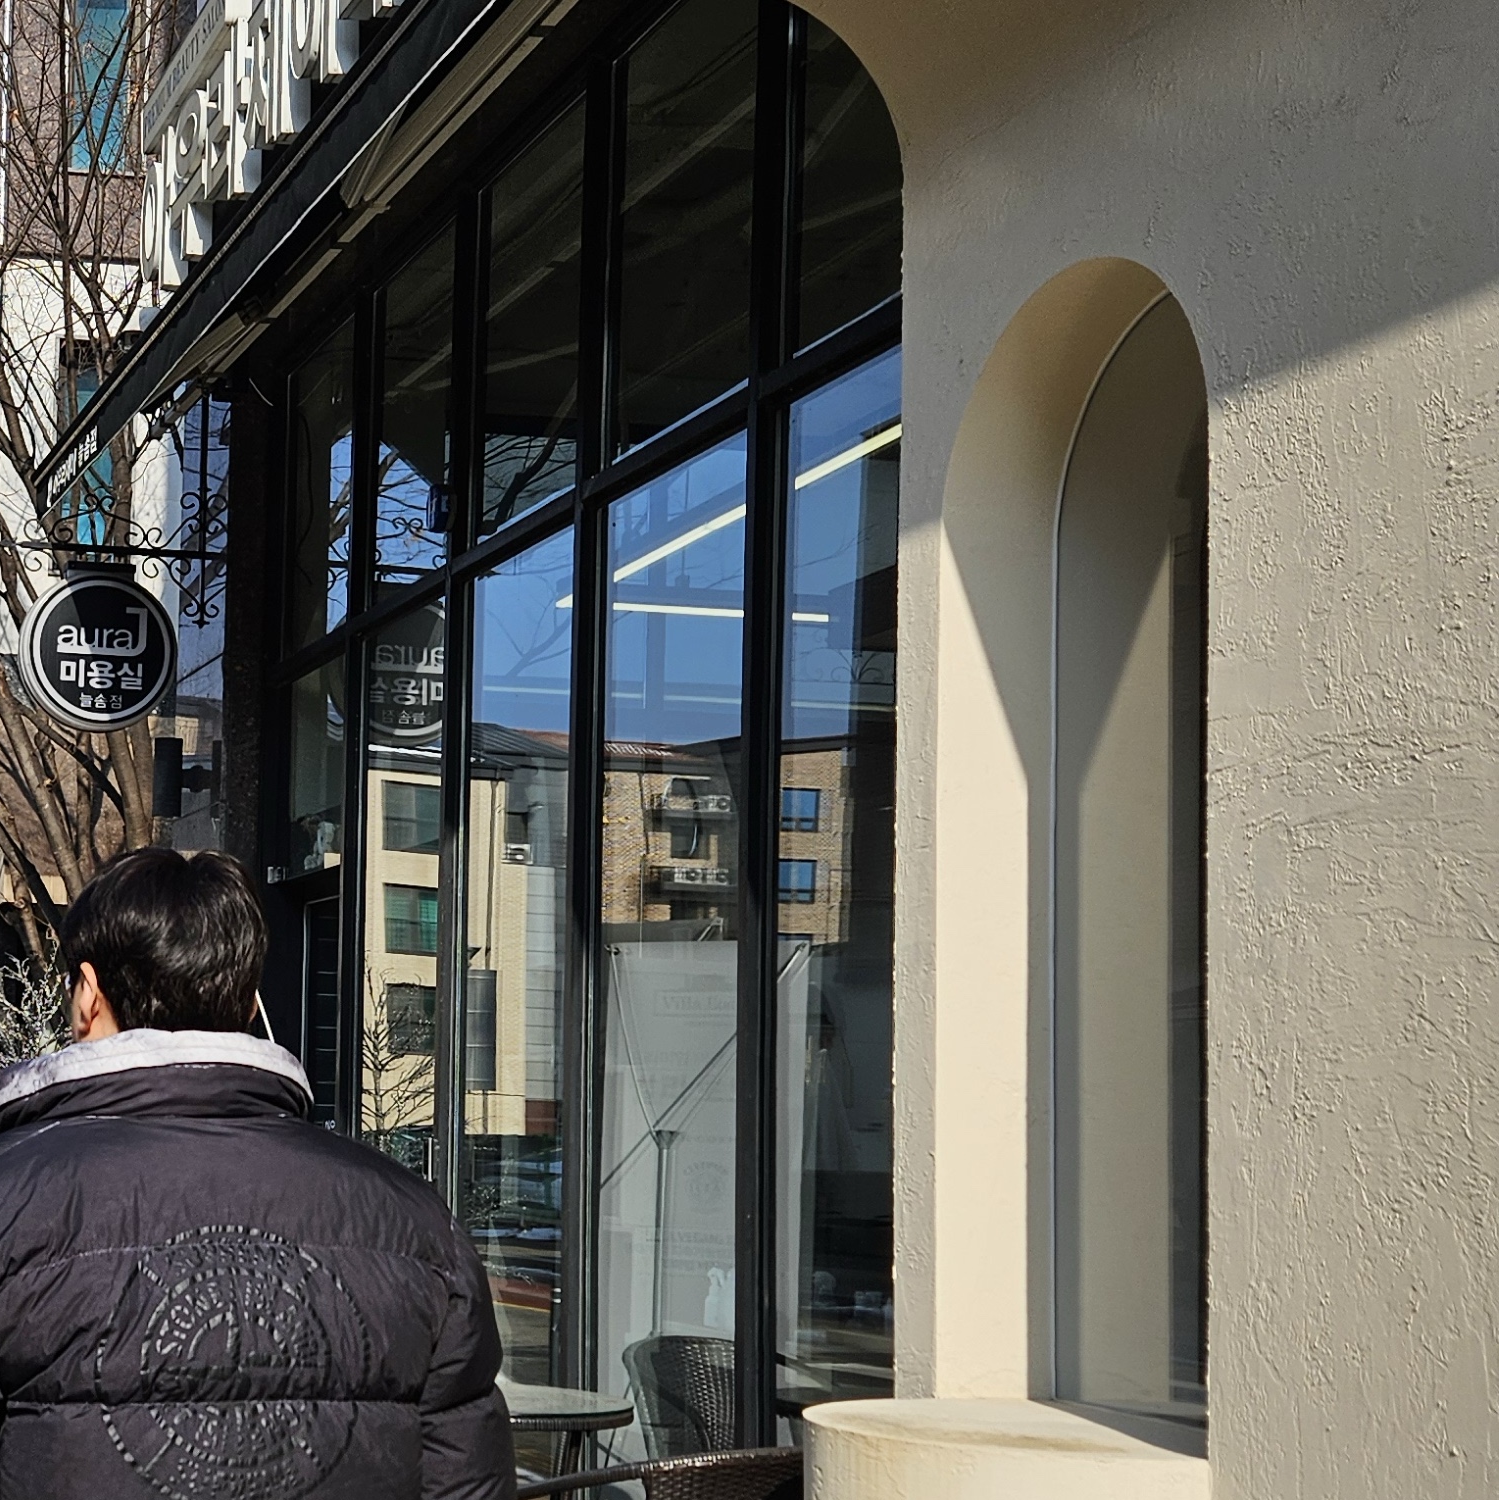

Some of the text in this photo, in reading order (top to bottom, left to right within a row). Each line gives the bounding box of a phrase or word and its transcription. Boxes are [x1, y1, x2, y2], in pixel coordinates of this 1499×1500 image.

[60, 659, 143, 690] 미용실
[79, 692, 123, 709] 늘솜점
[155, 1280, 224, 1359] STONE
